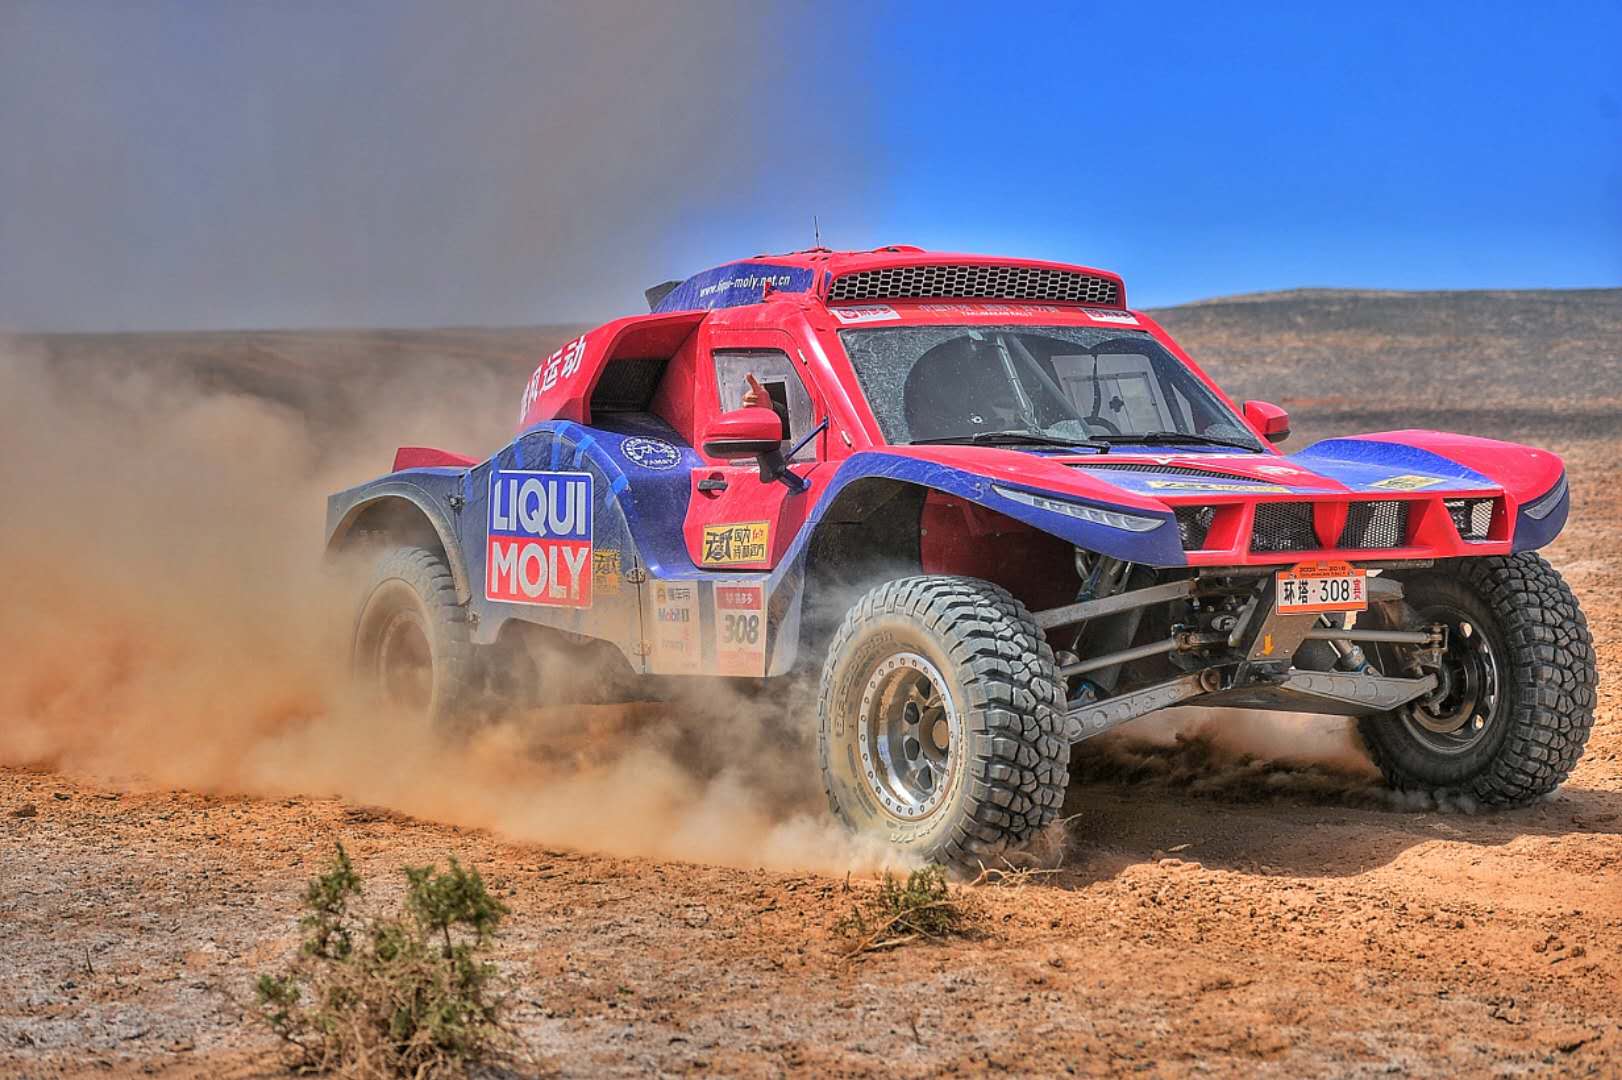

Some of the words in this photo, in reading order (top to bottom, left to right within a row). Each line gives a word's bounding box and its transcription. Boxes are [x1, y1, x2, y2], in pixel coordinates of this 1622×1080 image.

[493, 478, 586, 537] LIQUI
[491, 541, 590, 600] MOLY
[722, 614, 760, 645] 308
